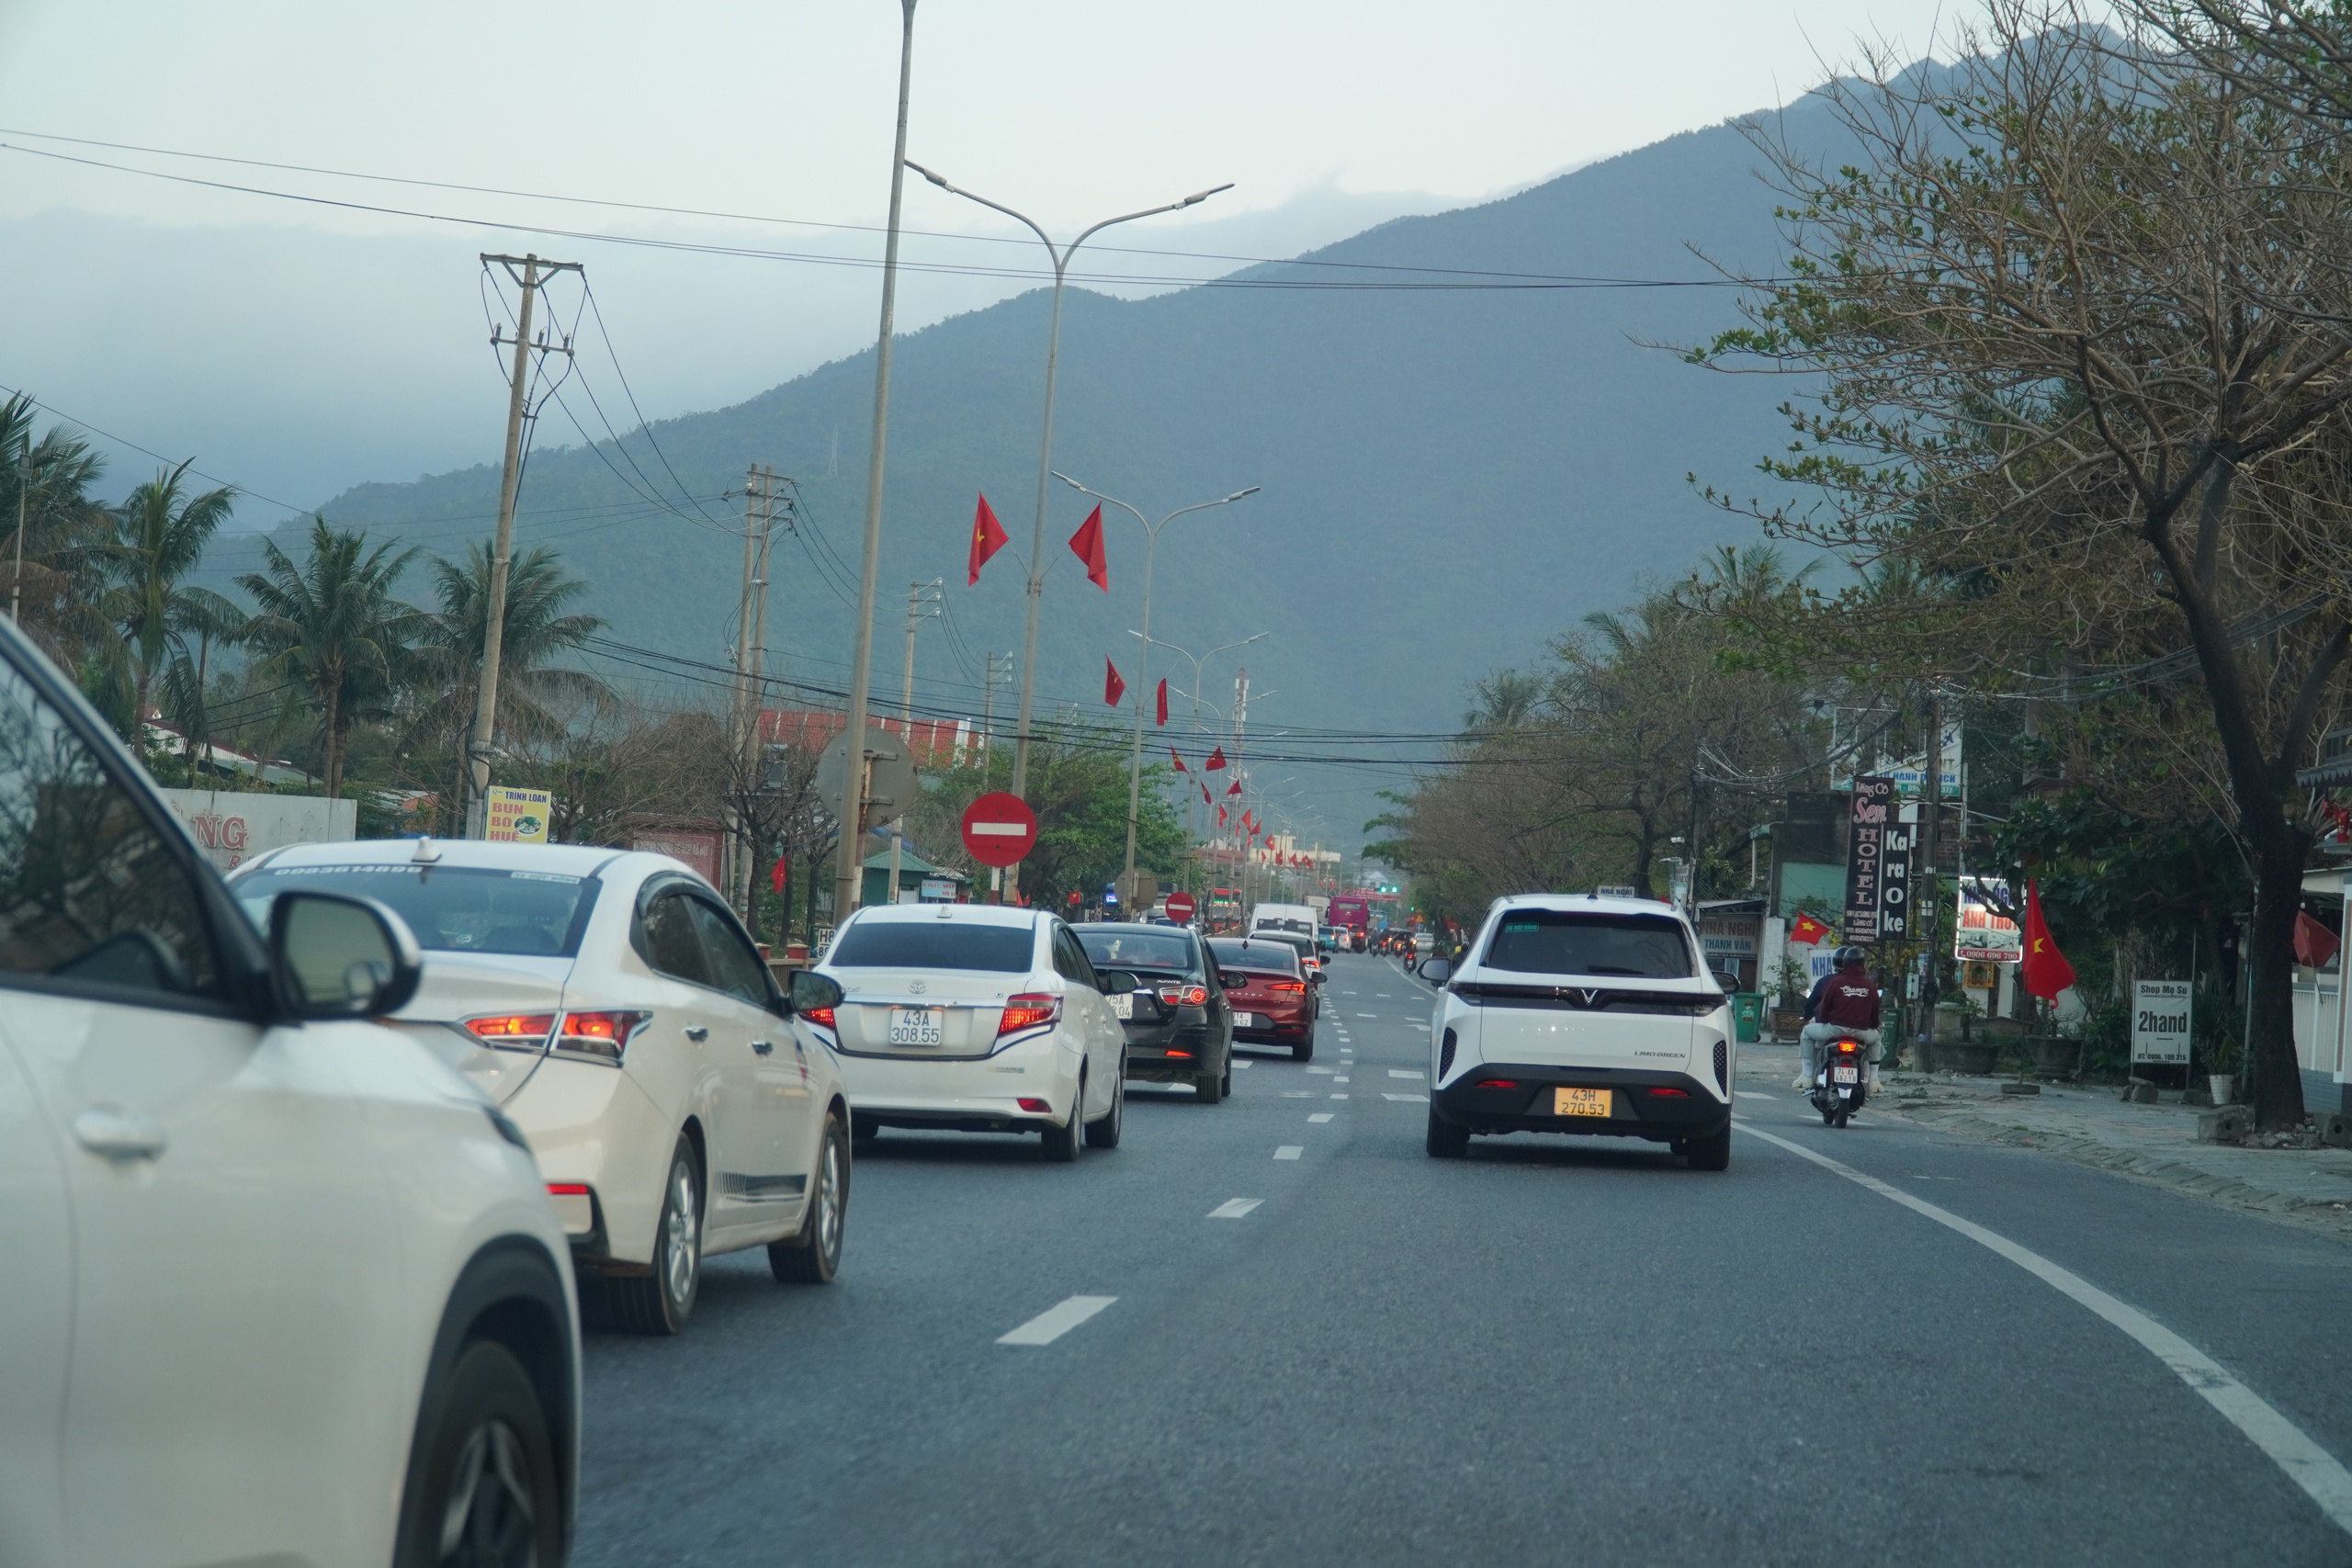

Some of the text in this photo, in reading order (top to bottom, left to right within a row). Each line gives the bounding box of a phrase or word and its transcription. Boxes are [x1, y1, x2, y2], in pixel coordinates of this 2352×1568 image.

[529, 793, 547, 803] LOAN
[492, 802, 524, 815] BÚN
[1853, 796, 1887, 824] Sen
[491, 816, 512, 828] BÒ
[190, 812, 249, 850] NG
[490, 829, 520, 842] HUẾ
[1856, 828, 1878, 906] HOTEL
[1962, 908, 1986, 928] ÁNH
[1705, 939, 1732, 950] THANH
[1812, 953, 1833, 976] NHÀ
[2140, 985, 2160, 994] Shop
[2177, 986, 2188, 994] Su
[904, 1010, 929, 1027] 43A
[2138, 1011, 2187, 1033] 2hand
[891, 1027, 939, 1043] 308.55
[1572, 1089, 1595, 1102] 43H
[1561, 1102, 1605, 1116] 270.53
